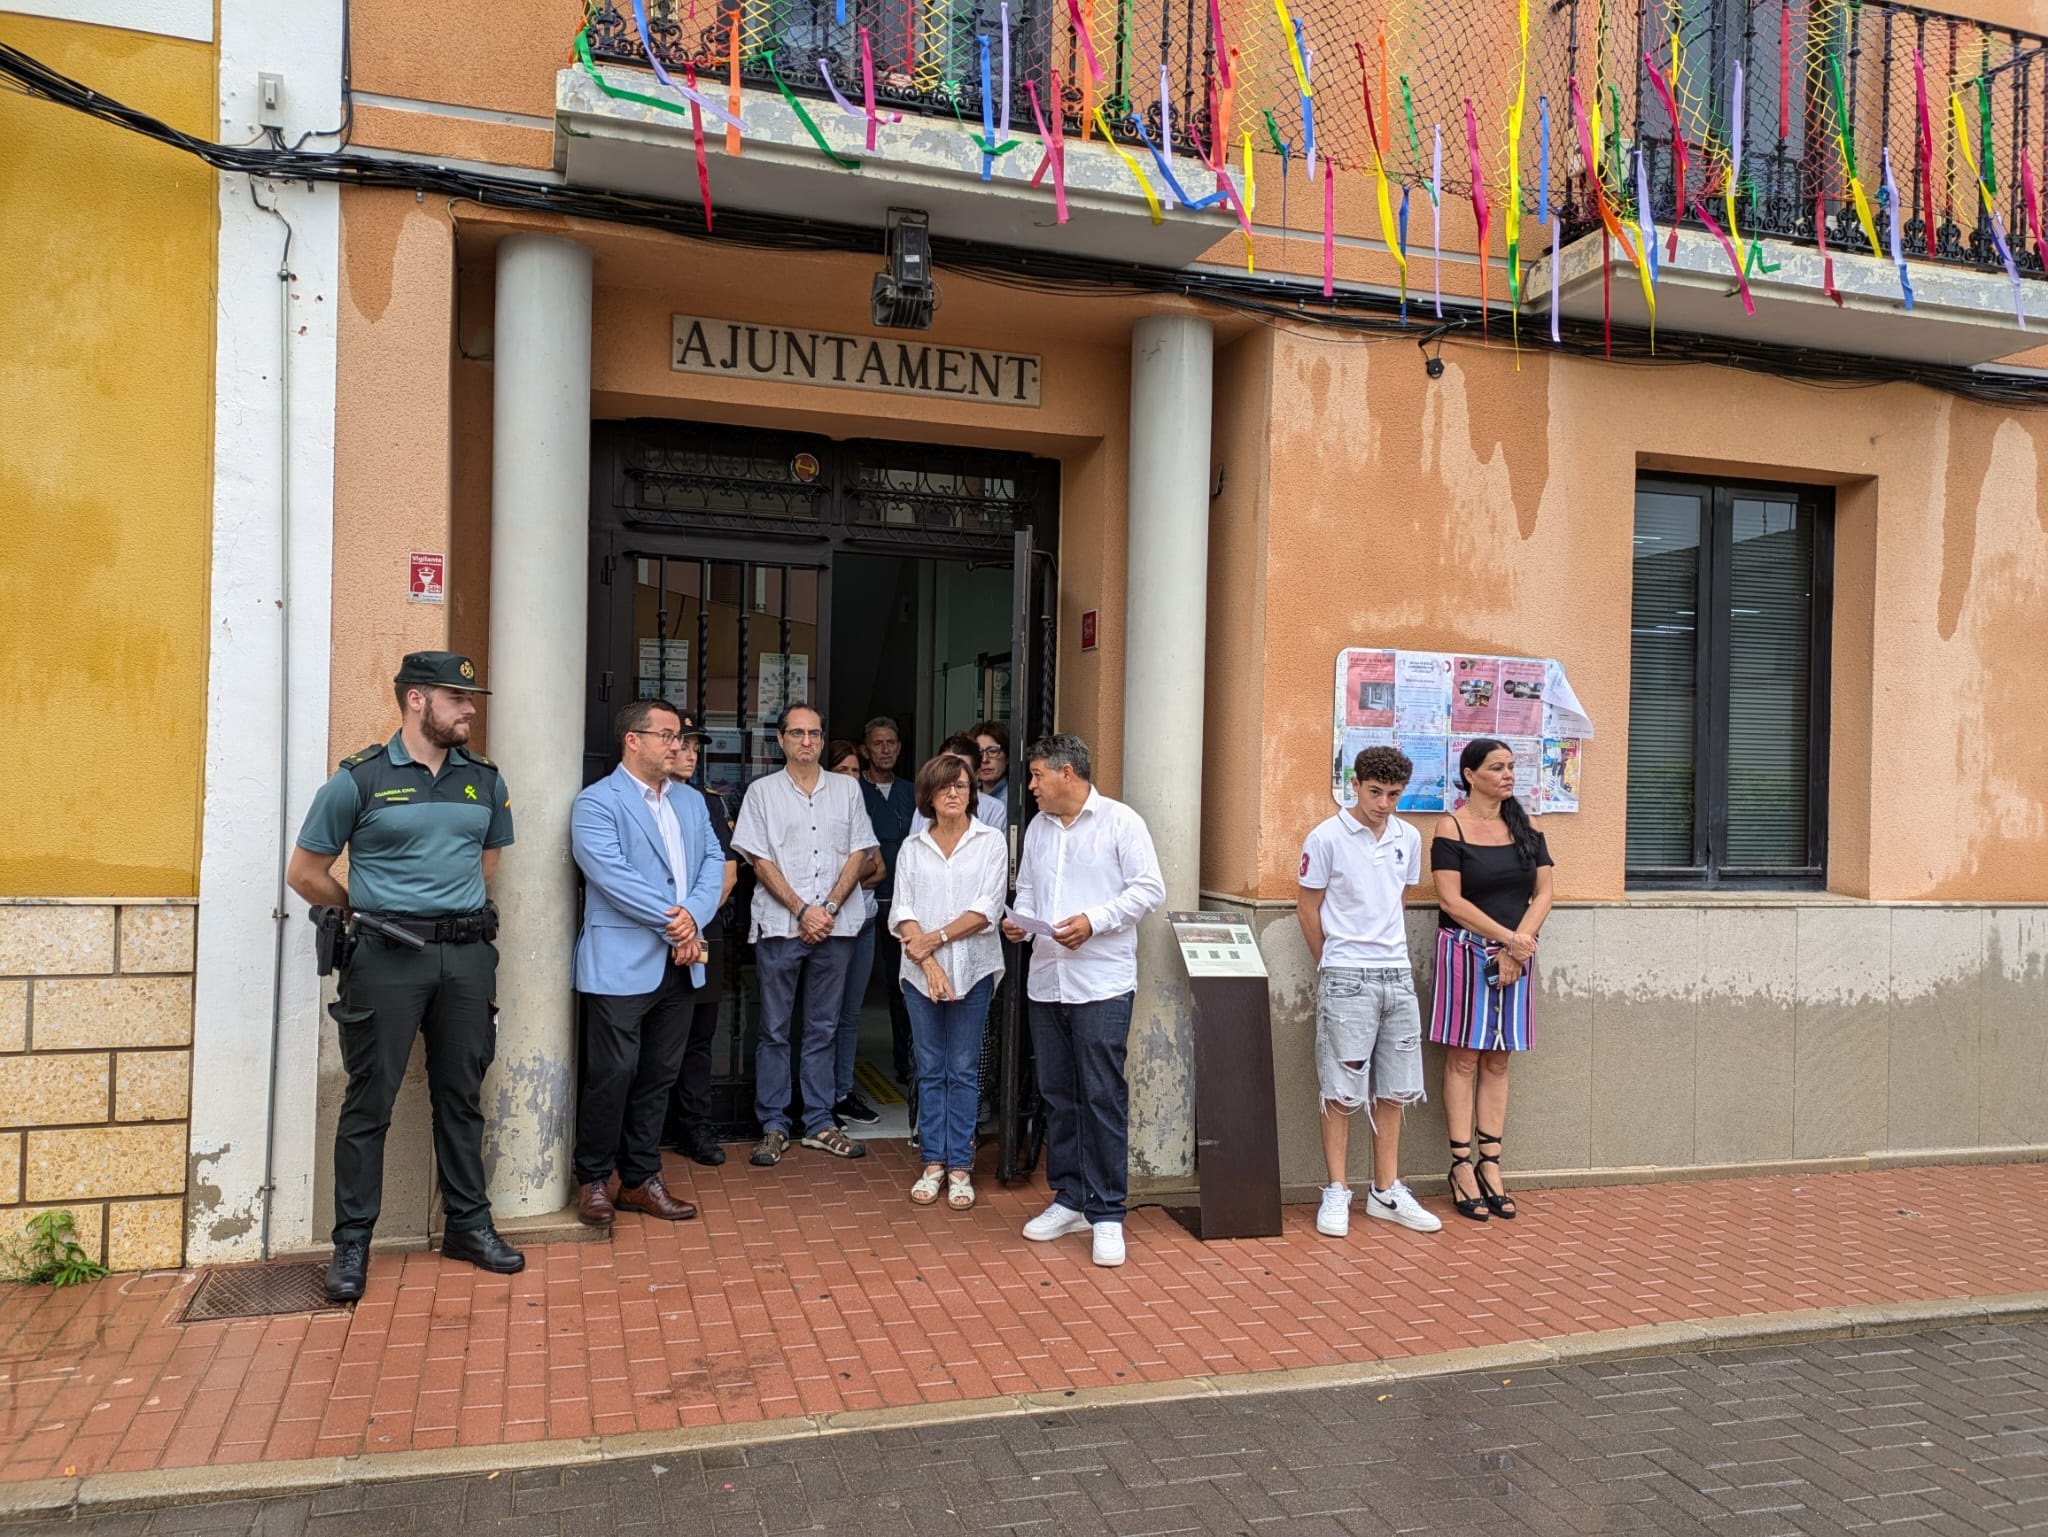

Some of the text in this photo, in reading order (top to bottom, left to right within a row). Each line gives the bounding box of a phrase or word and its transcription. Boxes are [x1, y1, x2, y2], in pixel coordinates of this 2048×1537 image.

[677, 321, 1038, 400] AJUNTAMENT
[411, 555, 442, 563] Vigilante
[374, 789, 401, 798] GUARDIA
